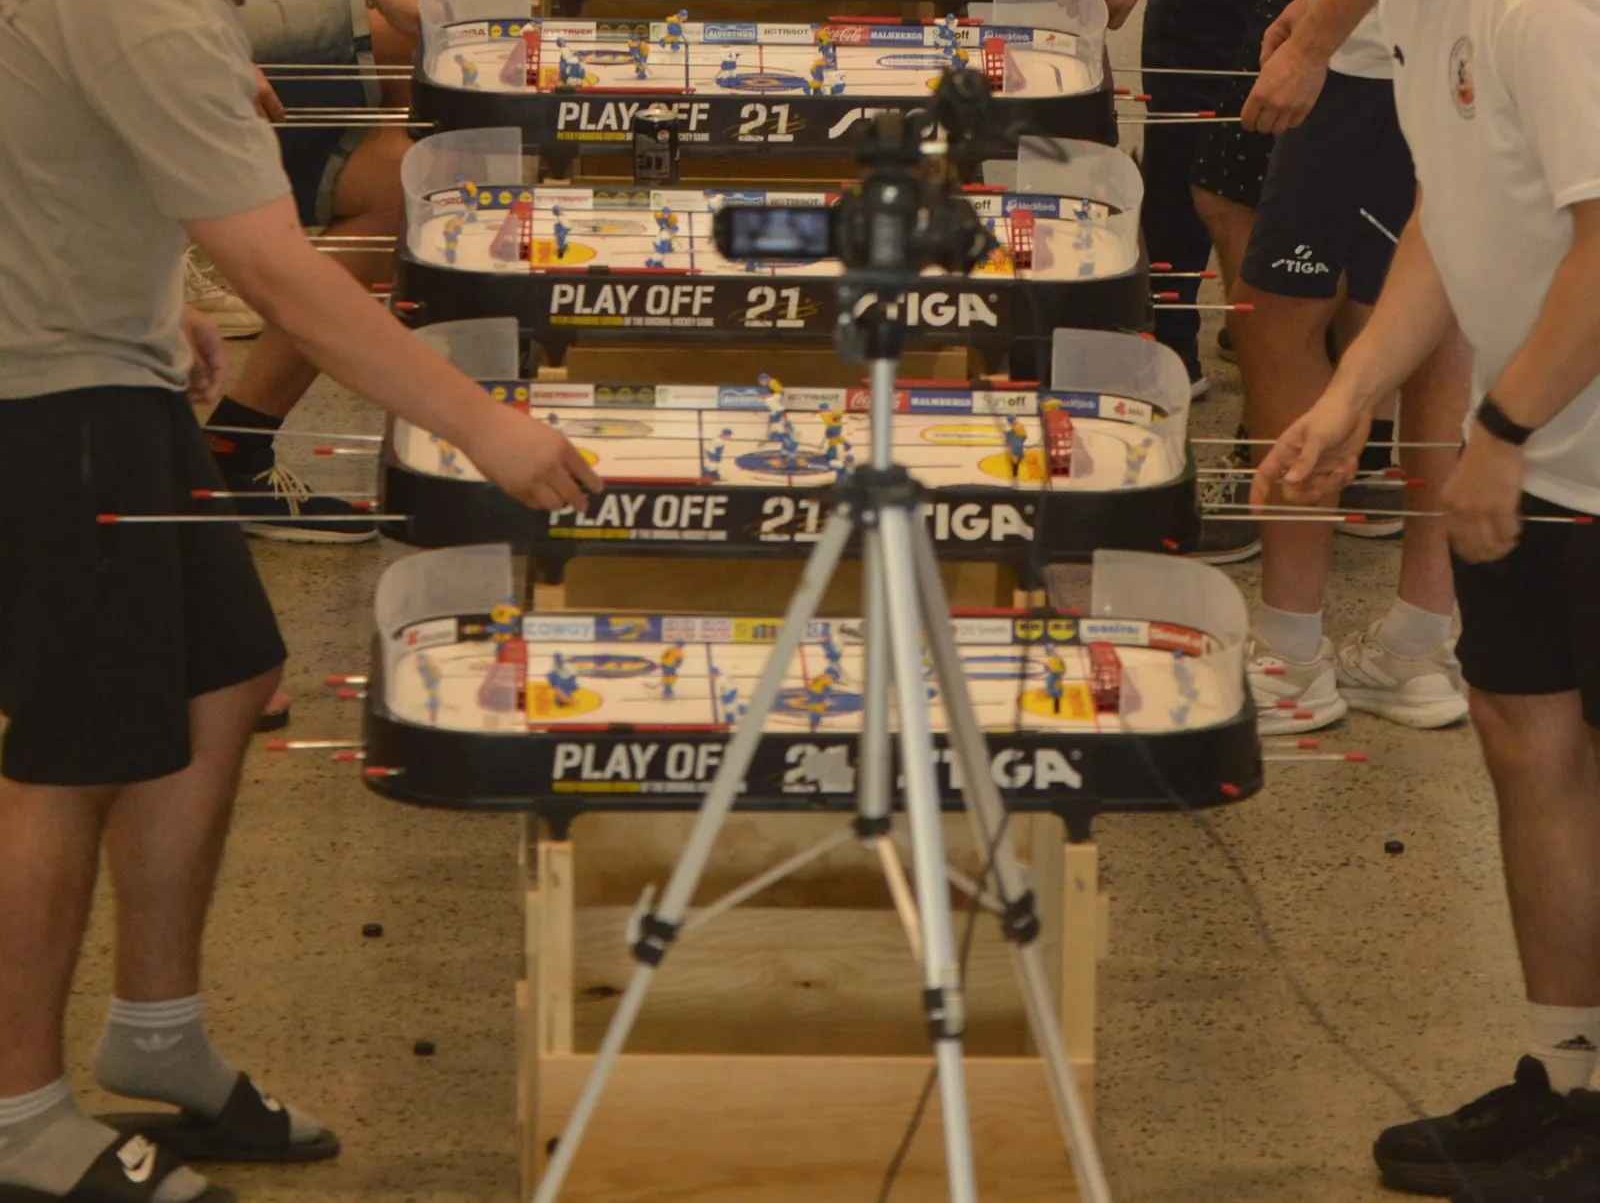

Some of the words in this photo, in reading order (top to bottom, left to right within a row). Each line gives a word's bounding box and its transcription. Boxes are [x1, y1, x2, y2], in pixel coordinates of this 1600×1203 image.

[557, 101, 639, 131] PLAY
[738, 102, 794, 142] 21
[1271, 258, 1329, 274] STIGA
[550, 284, 639, 315] PLAY
[645, 285, 715, 316] OFF
[744, 286, 805, 328] 21
[549, 494, 646, 526] PLAY
[652, 495, 729, 528] OFF
[760, 496, 824, 542] 21
[919, 503, 1034, 541] IGA
[552, 743, 659, 780] PLAY
[665, 743, 723, 780] OF
